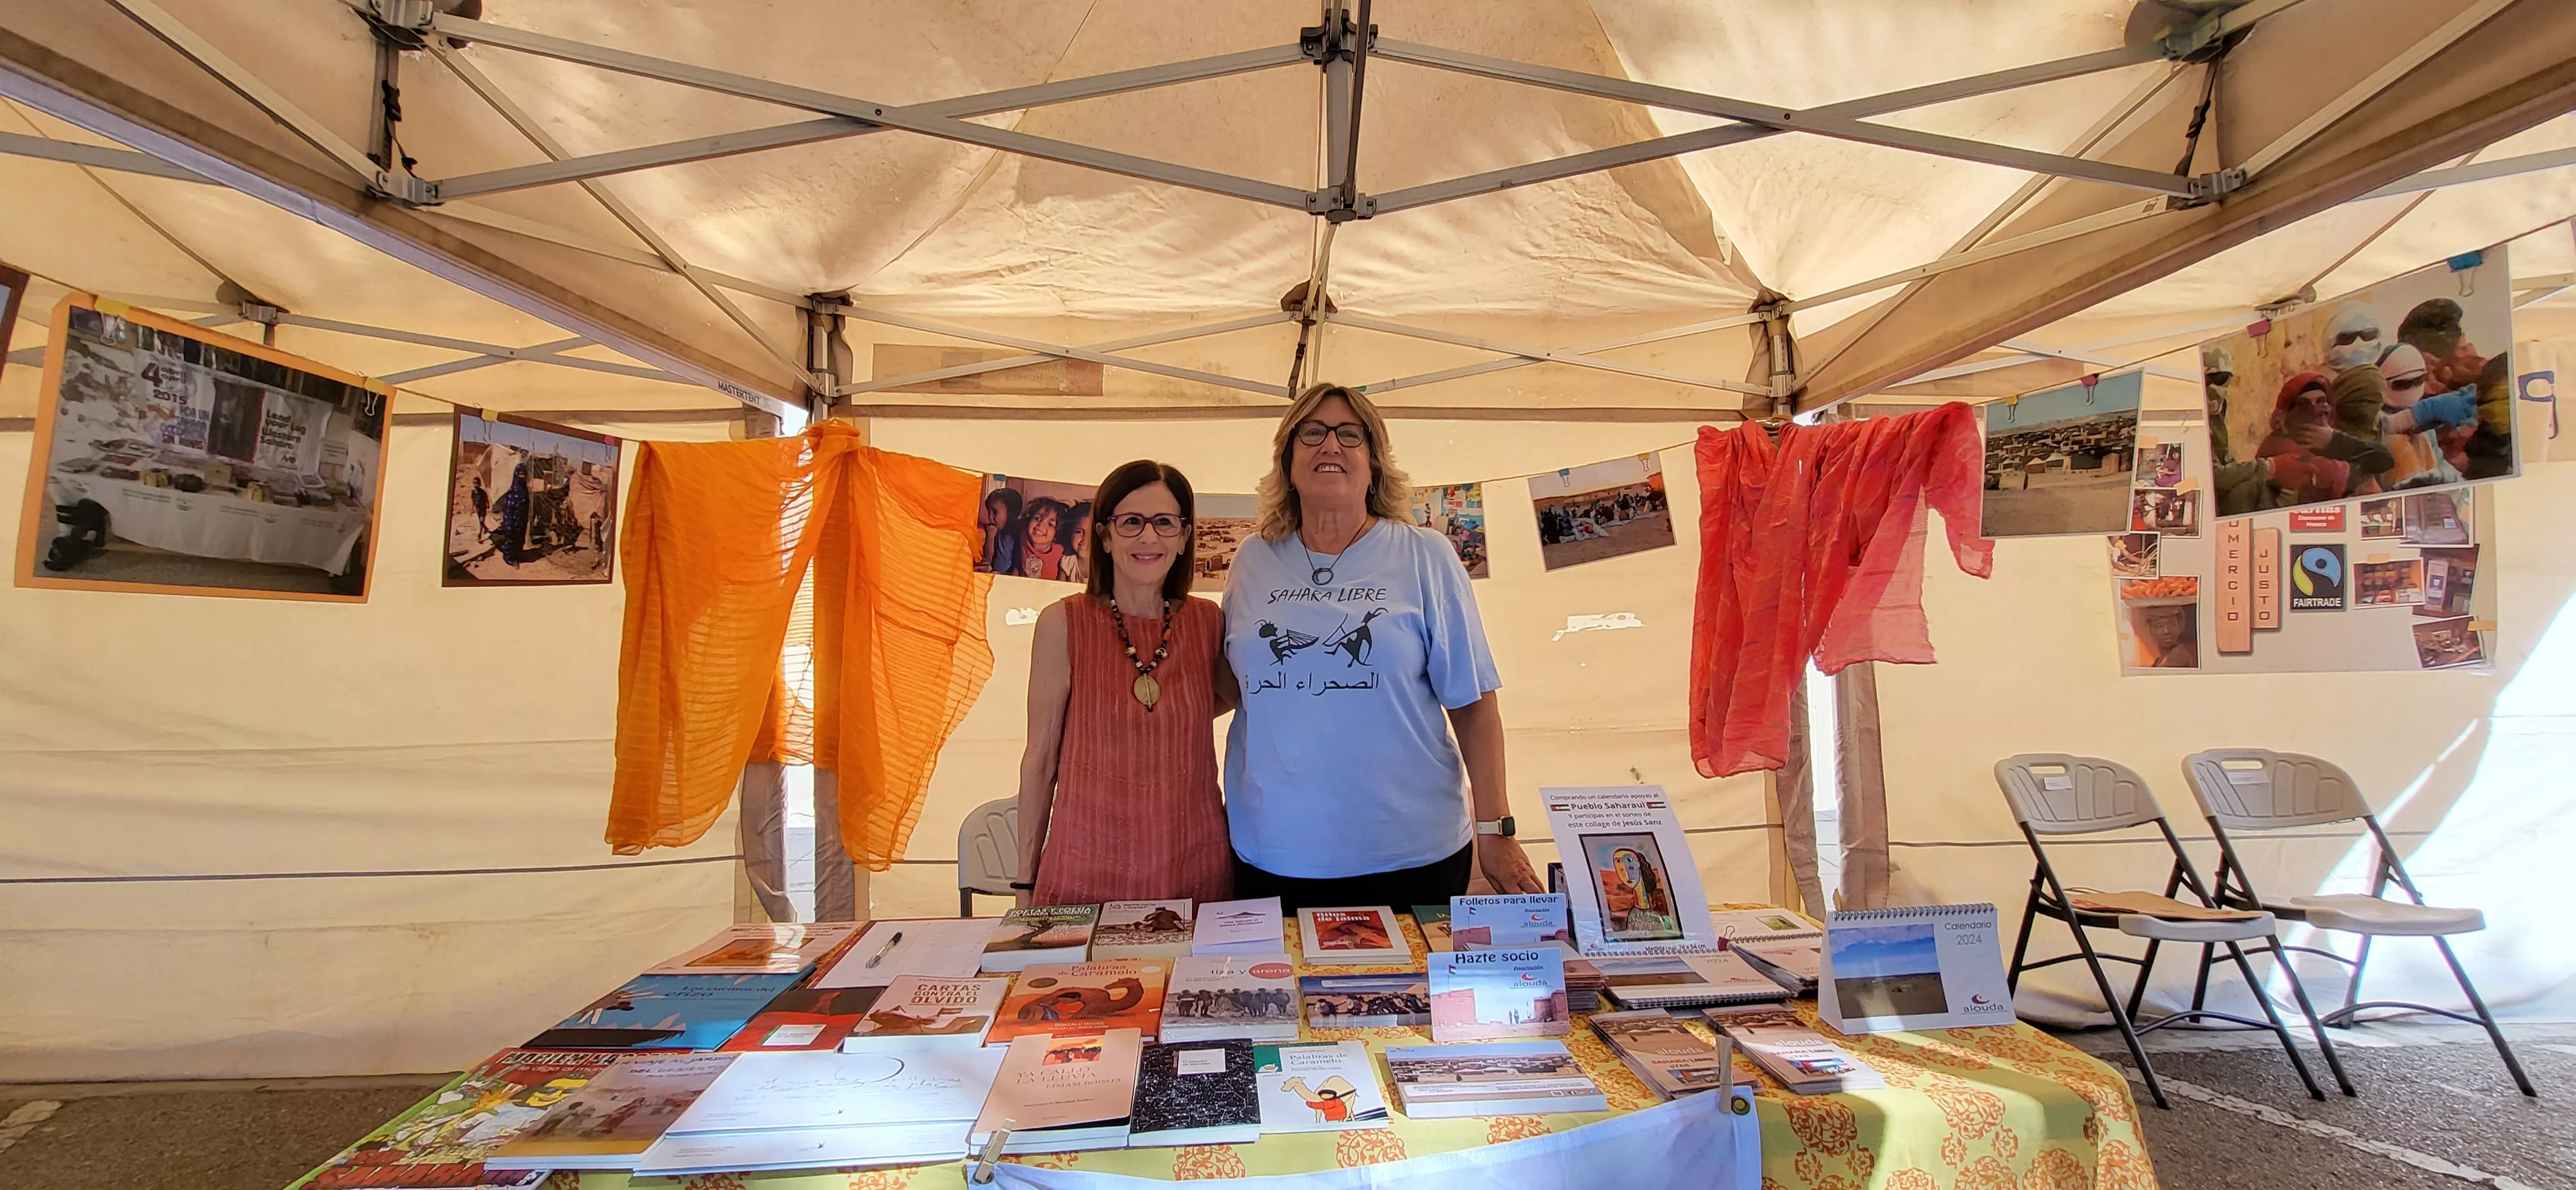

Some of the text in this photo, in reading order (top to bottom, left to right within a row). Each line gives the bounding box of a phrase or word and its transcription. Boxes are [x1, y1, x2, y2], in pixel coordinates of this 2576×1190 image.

[142, 362, 162, 387] 4
[153, 389, 187, 405] 2015
[717, 381, 760, 405] MASTERTENT
[2227, 520, 2240, 621] OMERCIO
[2259, 549, 2271, 621] JUSTO
[1267, 587, 1387, 605] SAHARA LIBRE
[2293, 598, 2342, 607] FAIRTRADE
[1296, 671, 1379, 696] الصحراء
[1571, 801, 1646, 810] Pueblo Saharaui
[1622, 819, 1643, 828] Jesús
[1459, 895, 1558, 906] Folletos para llevar
[1944, 921, 1992, 930] Calendario
[1956, 934, 1982, 945] 2024
[1455, 950, 1539, 964] Hazte socio
[1071, 968, 1138, 978] Caramelo
[1963, 1003, 2004, 1013] alouda
[1774, 1037, 1823, 1047] alouda
[1656, 1046, 1705, 1055] alouda
[1016, 1072, 1097, 1085] LA LLUVIA
